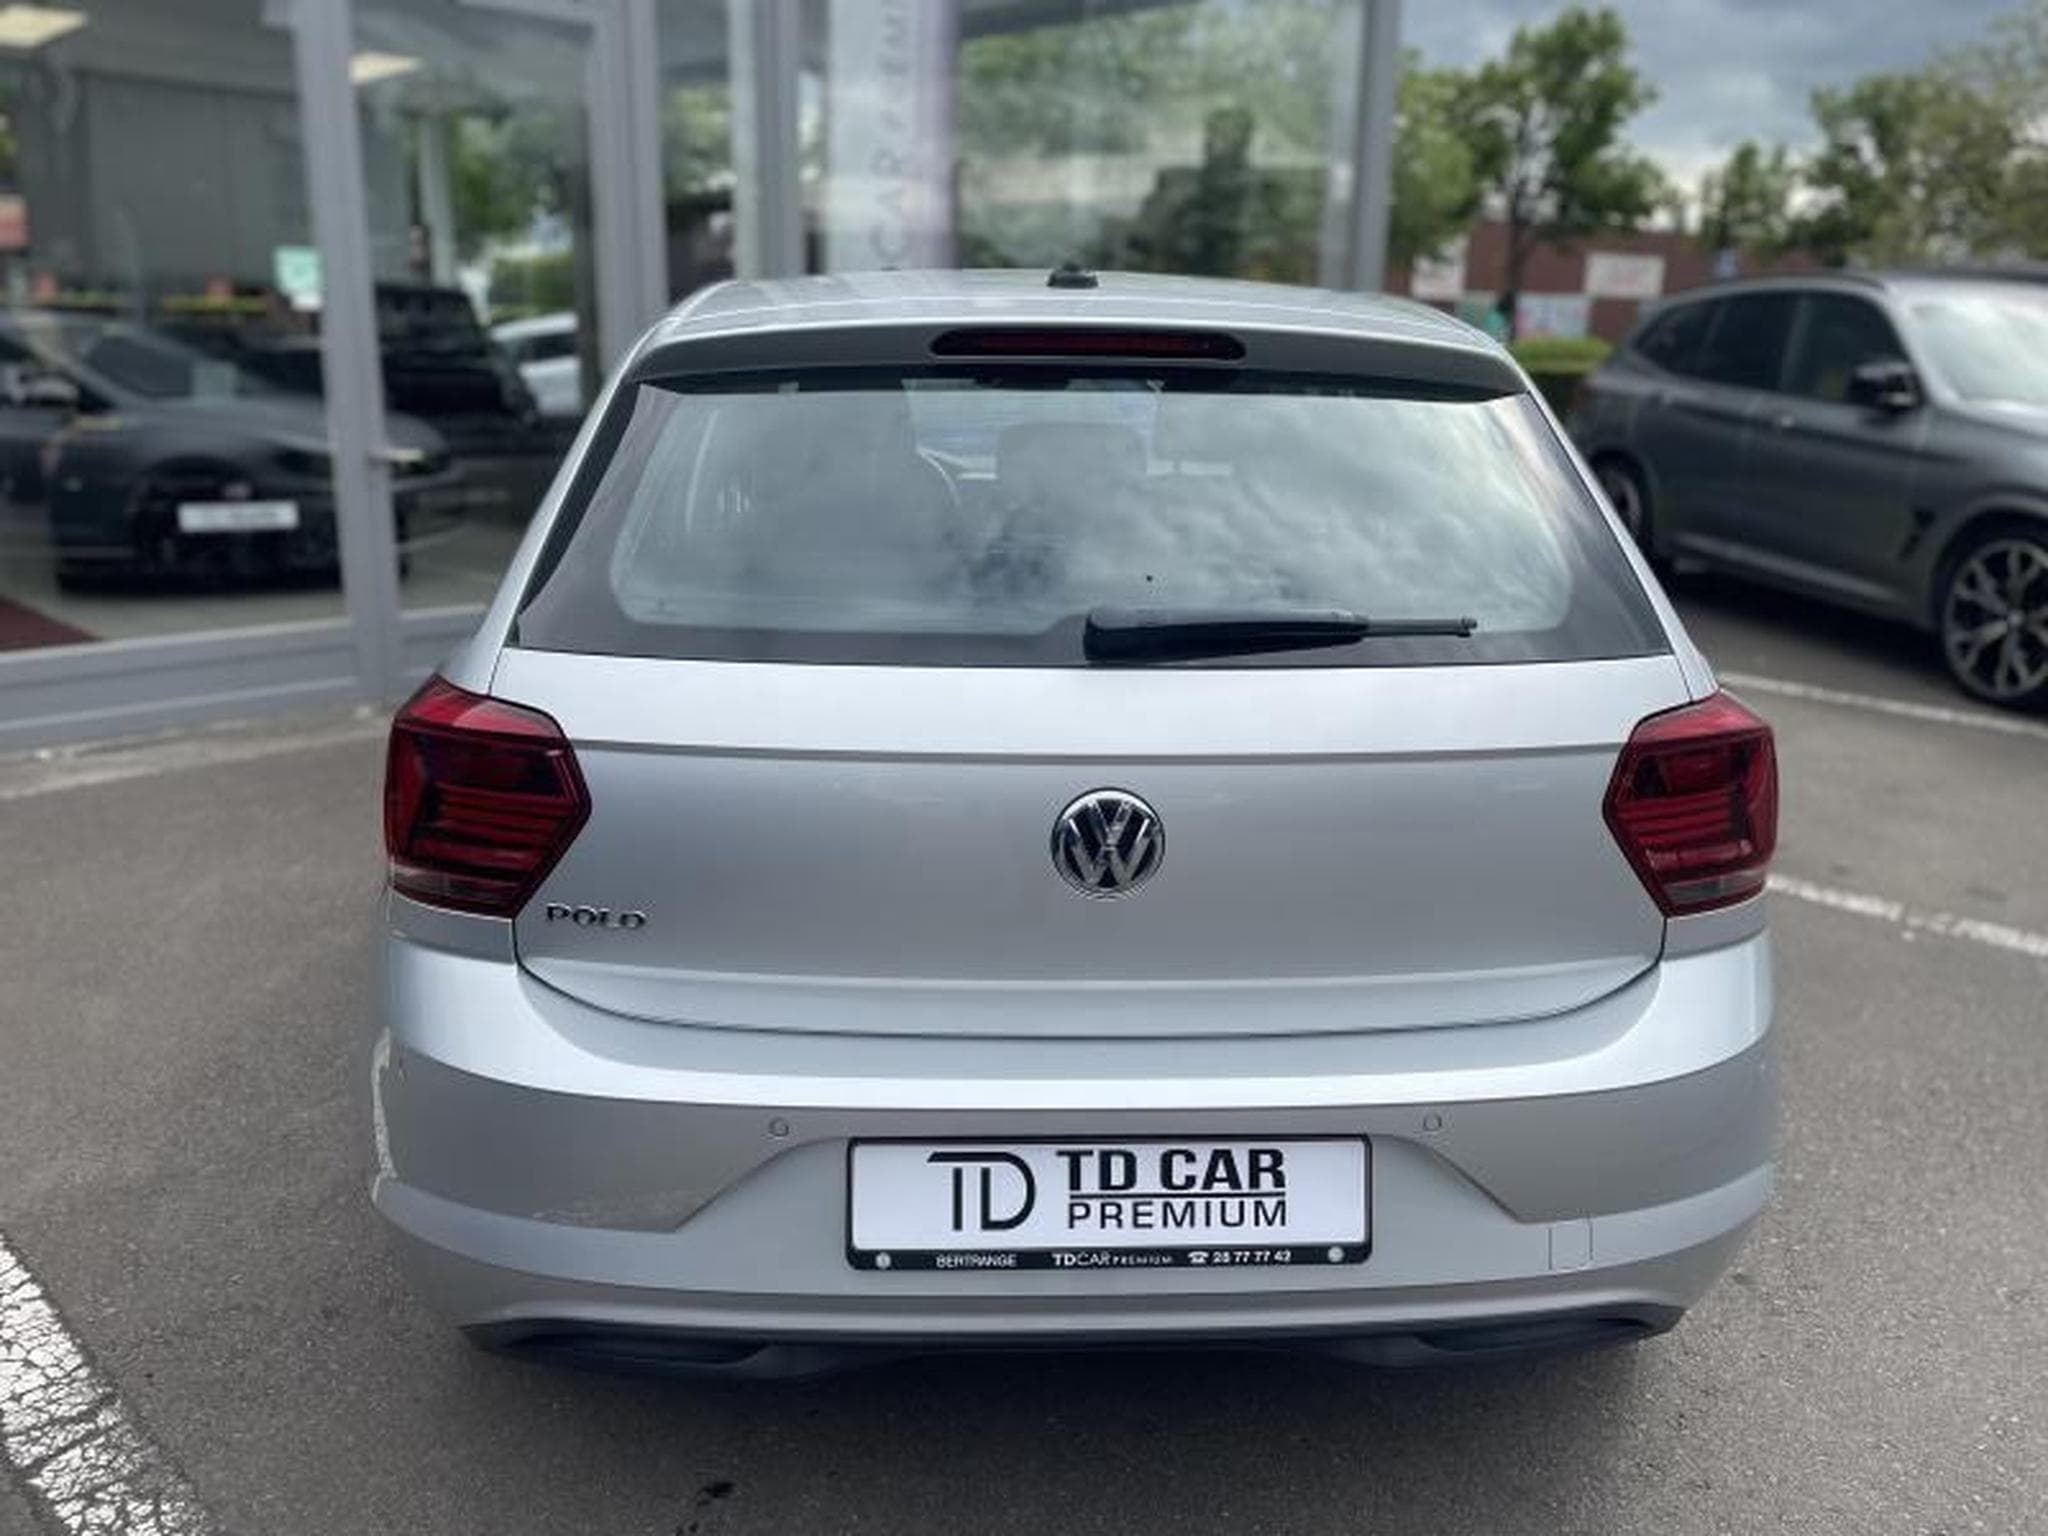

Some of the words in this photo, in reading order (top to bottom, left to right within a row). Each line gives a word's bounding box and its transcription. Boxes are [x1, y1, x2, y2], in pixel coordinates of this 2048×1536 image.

[545, 902, 648, 930] POLO
[1056, 1149, 1138, 1192] TD
[1160, 1148, 1286, 1191] CAR
[1068, 1199, 1287, 1230] PREMIUM
[936, 1253, 1017, 1268] BERTRANGE
[1232, 1250, 1250, 1263] 77
[1253, 1250, 1271, 1262] 77
